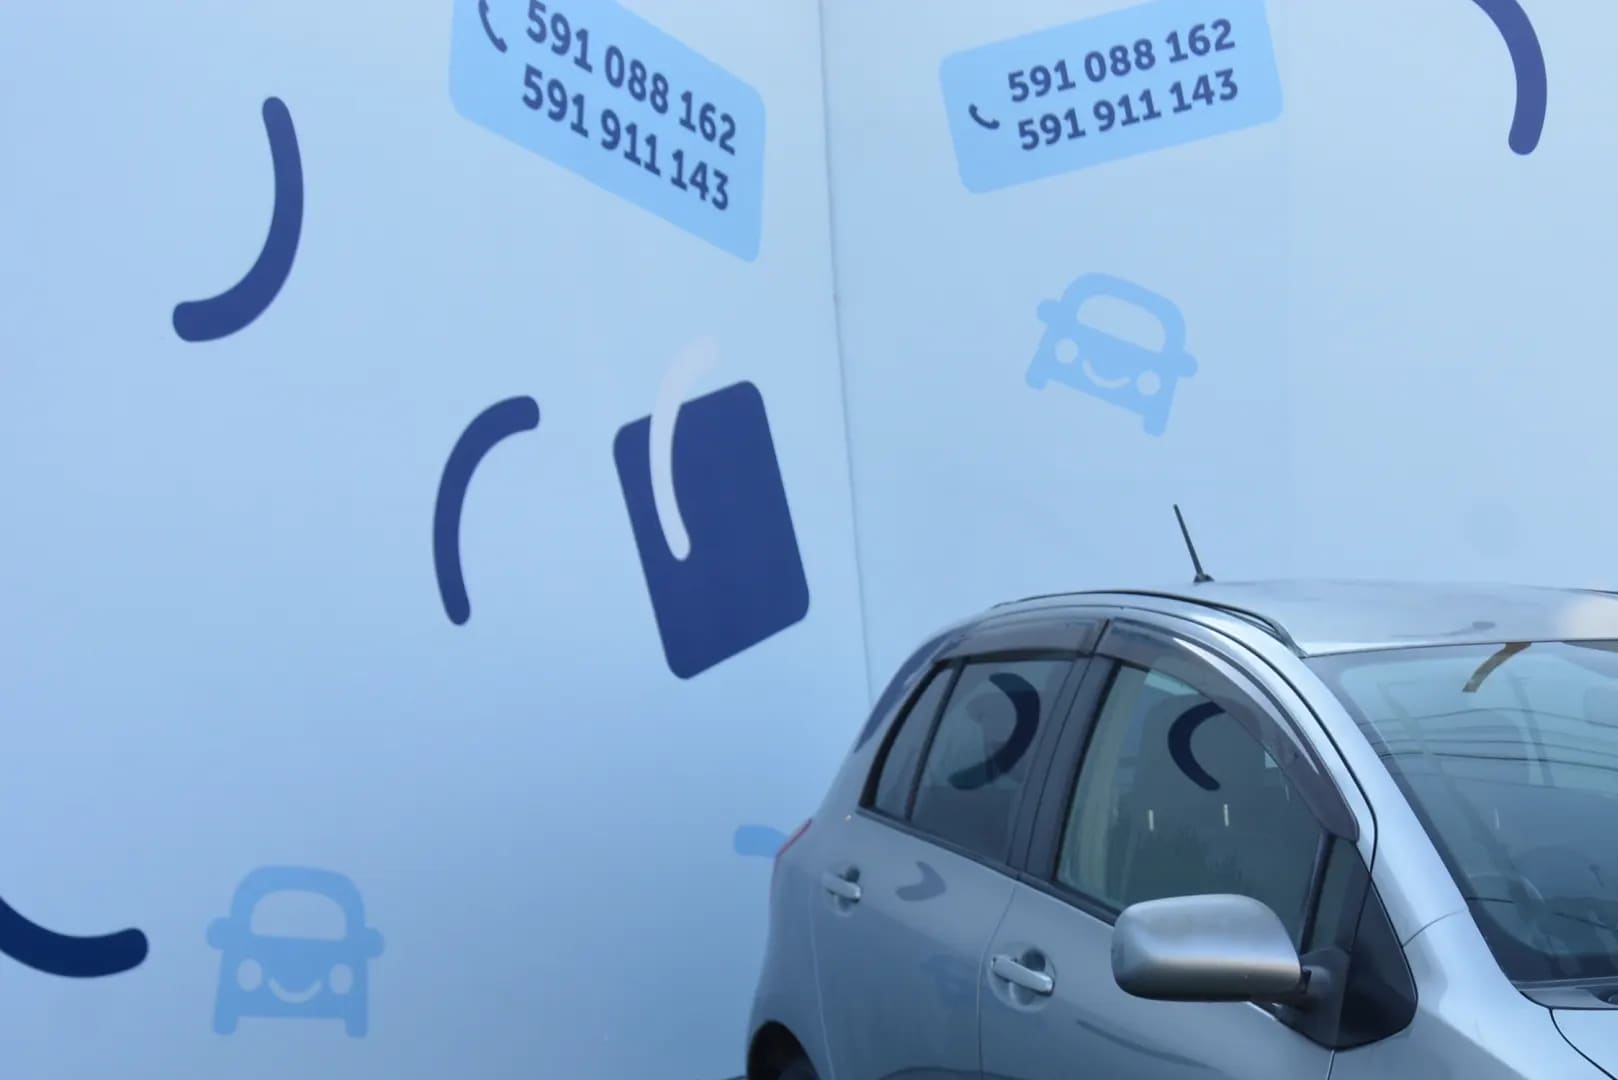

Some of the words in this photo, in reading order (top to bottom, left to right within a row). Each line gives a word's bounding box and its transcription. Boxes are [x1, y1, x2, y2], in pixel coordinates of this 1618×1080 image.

[526, 0, 593, 73] 591
[605, 45, 669, 114] 088
[679, 90, 736, 156] 162
[1008, 59, 1076, 102] 591
[1084, 38, 1156, 83] 088
[1165, 18, 1236, 63] 162
[1018, 107, 1086, 151] 591
[1093, 88, 1162, 132] 911
[1169, 68, 1238, 114] 143
[522, 63, 589, 138] 591
[601, 108, 661, 177] 911
[670, 149, 729, 211] 143
